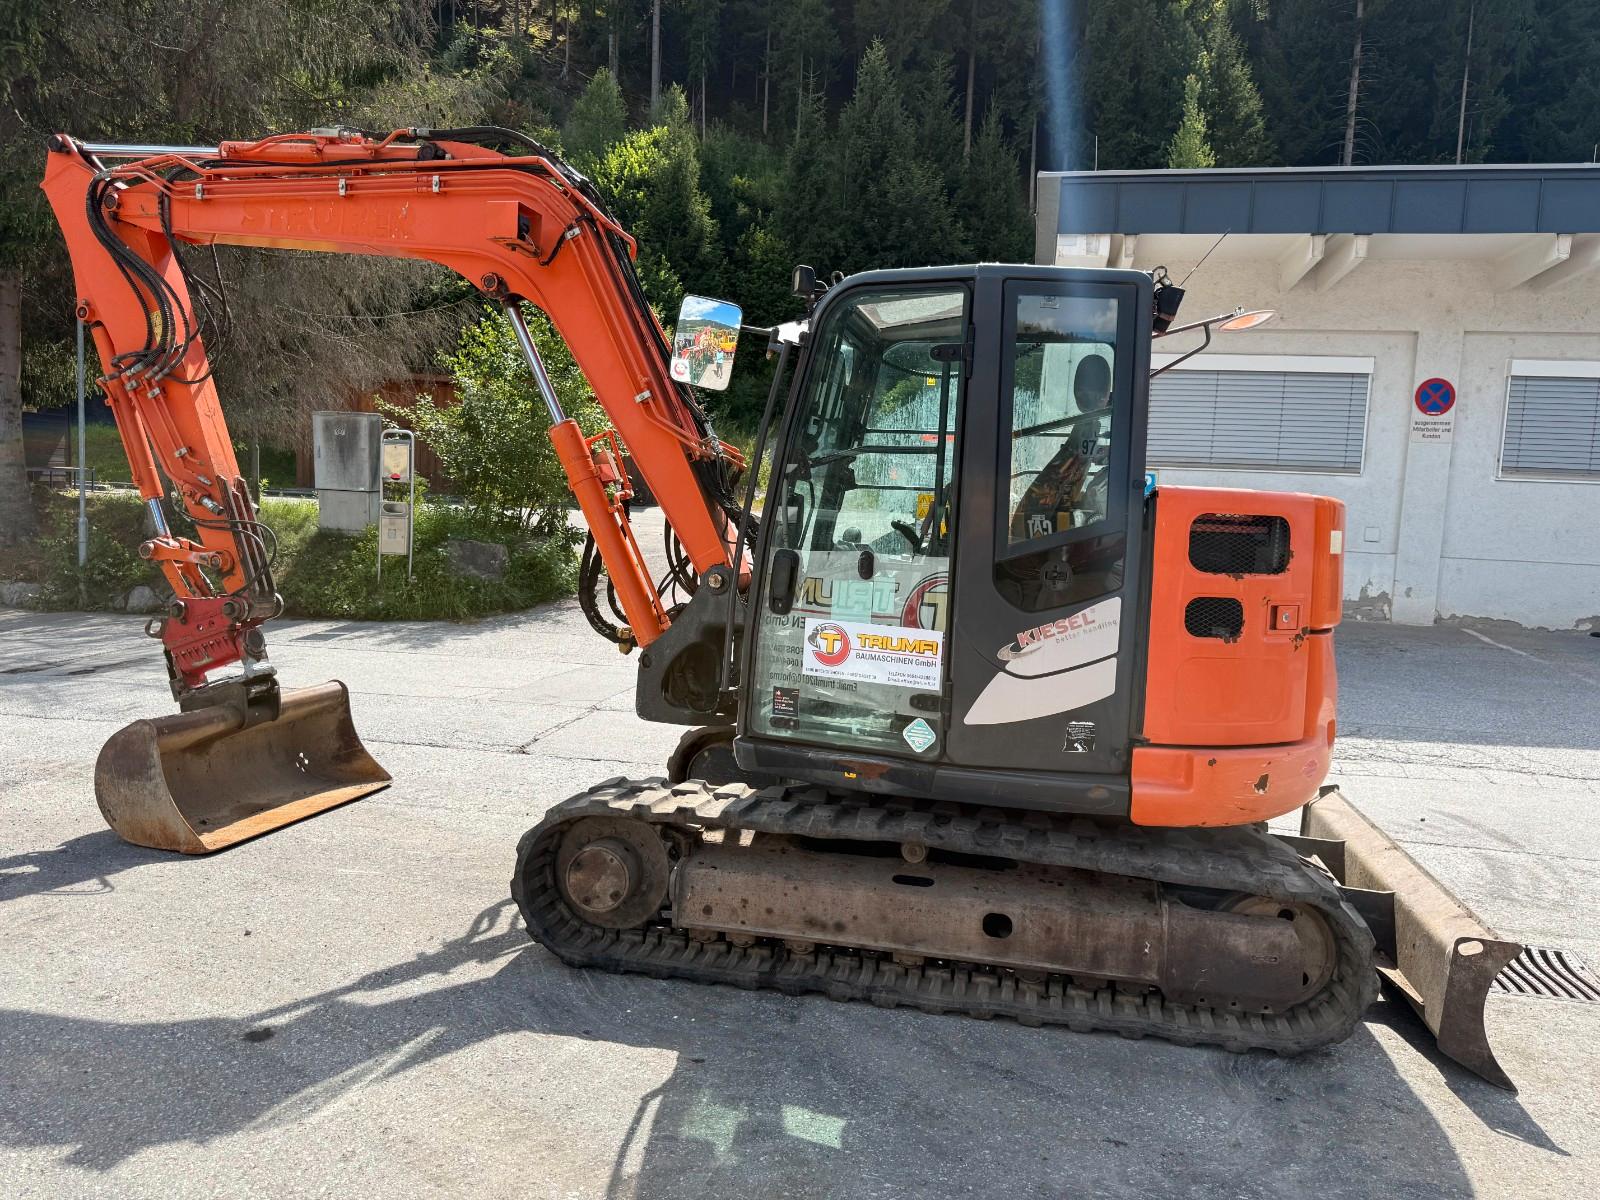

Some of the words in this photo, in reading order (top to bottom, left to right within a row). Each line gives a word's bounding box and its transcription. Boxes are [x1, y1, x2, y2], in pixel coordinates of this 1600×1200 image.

[1082, 439, 1097, 455] 97
[1016, 613, 1096, 648] KIESEL
[1056, 631, 1080, 644] better
[820, 632, 842, 655] T
[857, 633, 938, 655] TRIUMFI
[855, 653, 914, 665] BAUMASCHINEN
[914, 658, 937, 668] GmbH
